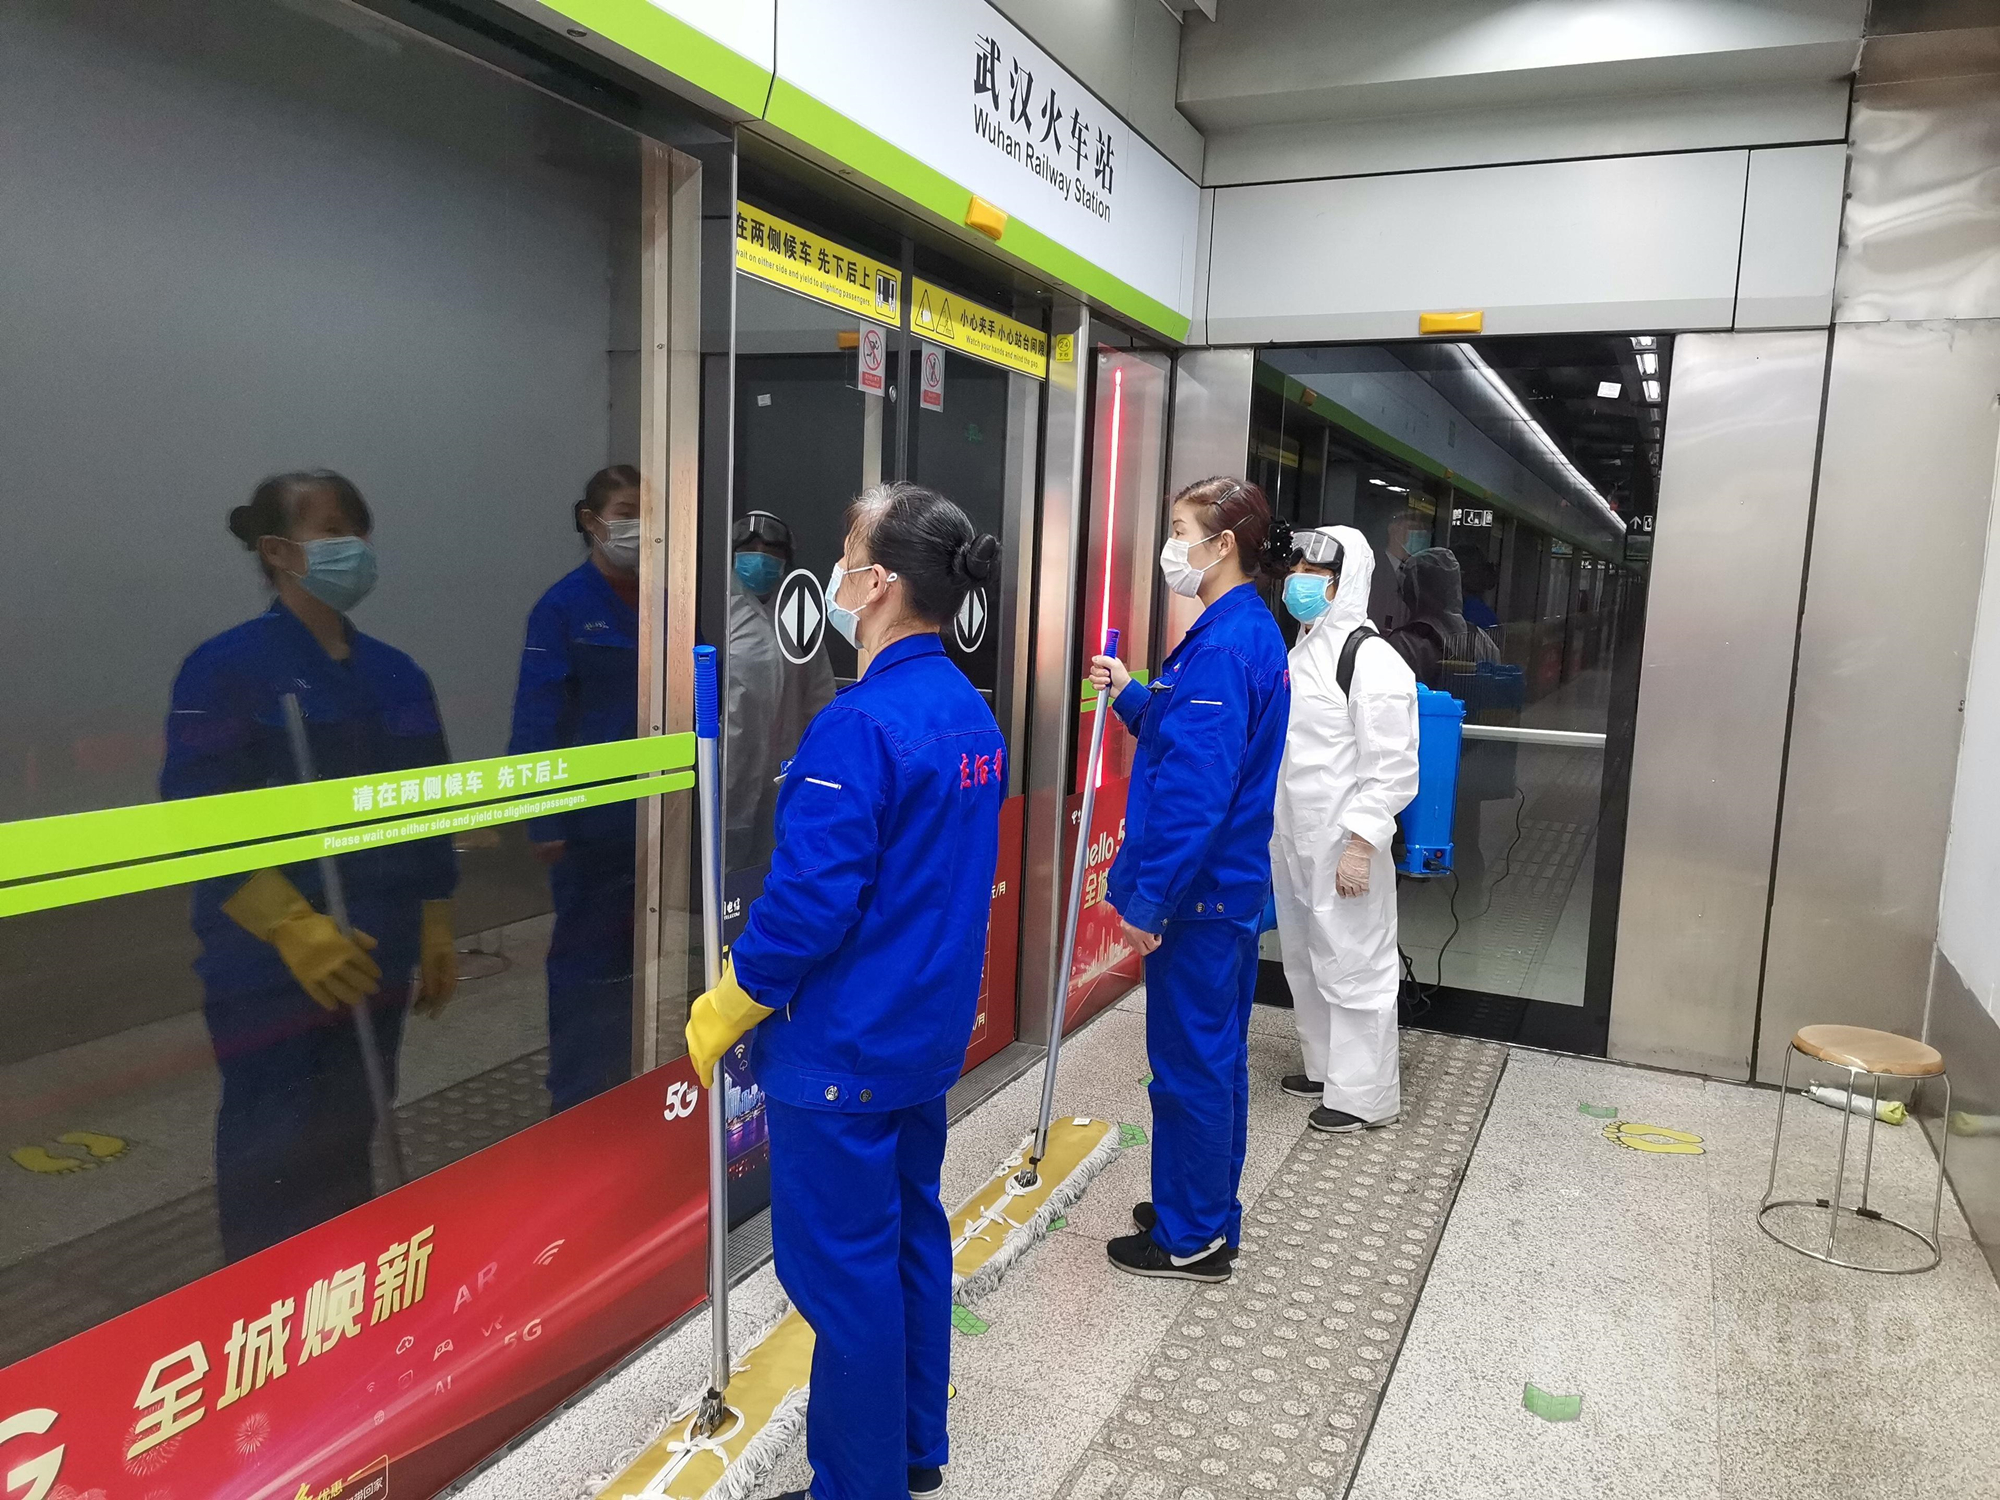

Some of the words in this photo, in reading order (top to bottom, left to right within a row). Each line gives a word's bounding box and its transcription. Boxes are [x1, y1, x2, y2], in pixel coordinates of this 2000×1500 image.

[974, 33, 1115, 195] 武汉火车站
[974, 103, 1021, 163] Wuhan
[1026, 141, 1071, 201] Railway
[1075, 177, 1111, 223] Station
[736, 212, 812, 267] 在两侧候车
[817, 247, 871, 291] 先下后上
[749, 254, 757, 264] on
[757, 256, 775, 270] either
[775, 262, 788, 275] side
[788, 268, 799, 280] and
[799, 271, 813, 286] yield
[813, 277, 820, 287] to
[820, 279, 842, 298] alighting
[960, 308, 996, 338] 小心夹手
[998, 323, 1046, 358] 小心站台间隙
[966, 334, 980, 347] Watch
[980, 340, 992, 351] your
[991, 344, 1005, 357] hands
[1004, 350, 1013, 360] and
[1013, 352, 1024, 363] mind
[1059, 340, 1069, 349] 24
[352, 769, 484, 812] 请在两侧候车
[497, 757, 569, 790] 先下后上
[324, 834, 360, 850] Please
[362, 829, 384, 843] wait
[386, 828, 399, 839] on
[400, 821, 430, 836] either
[430, 816, 451, 830] side
[452, 813, 470, 827] and
[470, 810, 492, 826] yield
[493, 808, 502, 820] to
[503, 803, 541, 818] alighting
[541, 794, 588, 812] passengers.
[663, 1081, 698, 1121] 5G
[453, 1261, 498, 1315] AR
[127, 1224, 436, 1461] 全城焕新
[504, 1318, 543, 1350] 5G
[434, 1375, 452, 1396] AI
